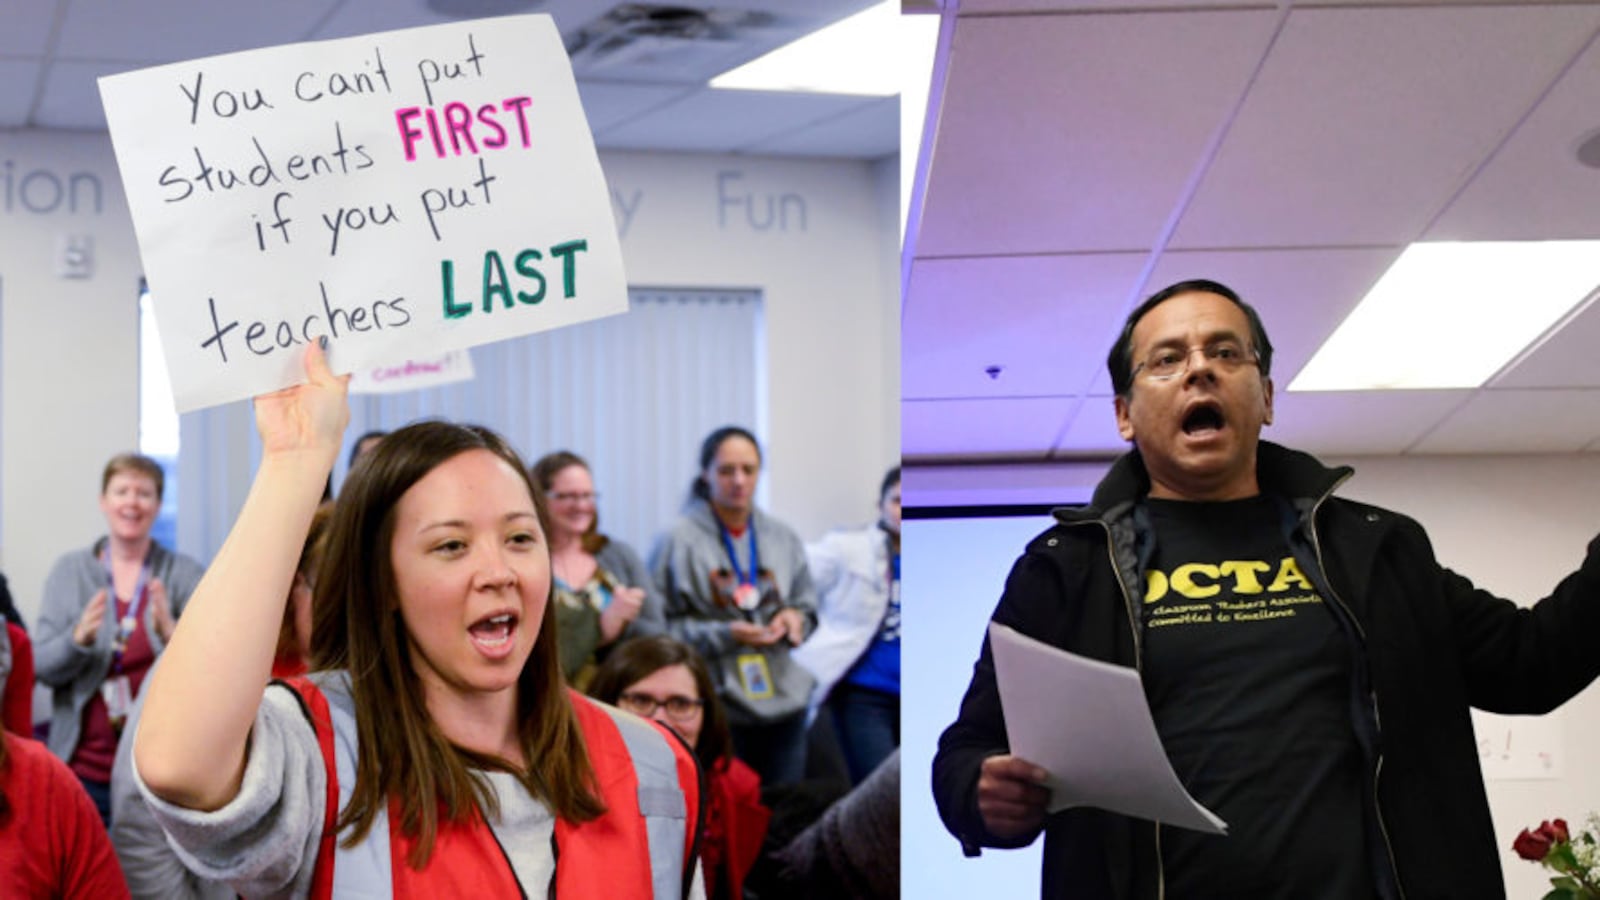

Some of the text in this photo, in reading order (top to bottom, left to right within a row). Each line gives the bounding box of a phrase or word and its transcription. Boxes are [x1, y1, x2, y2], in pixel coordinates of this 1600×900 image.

[180, 72, 275, 124] You
[418, 33, 486, 105] put
[394, 96, 533, 162] FIRST
[0, 159, 103, 214] ion
[252, 158, 497, 256] if you put
[717, 170, 808, 232] Fun
[199, 239, 589, 363] teachers LAST
[1216, 611, 1231, 623] to
[1234, 608, 1296, 622] Excellence
